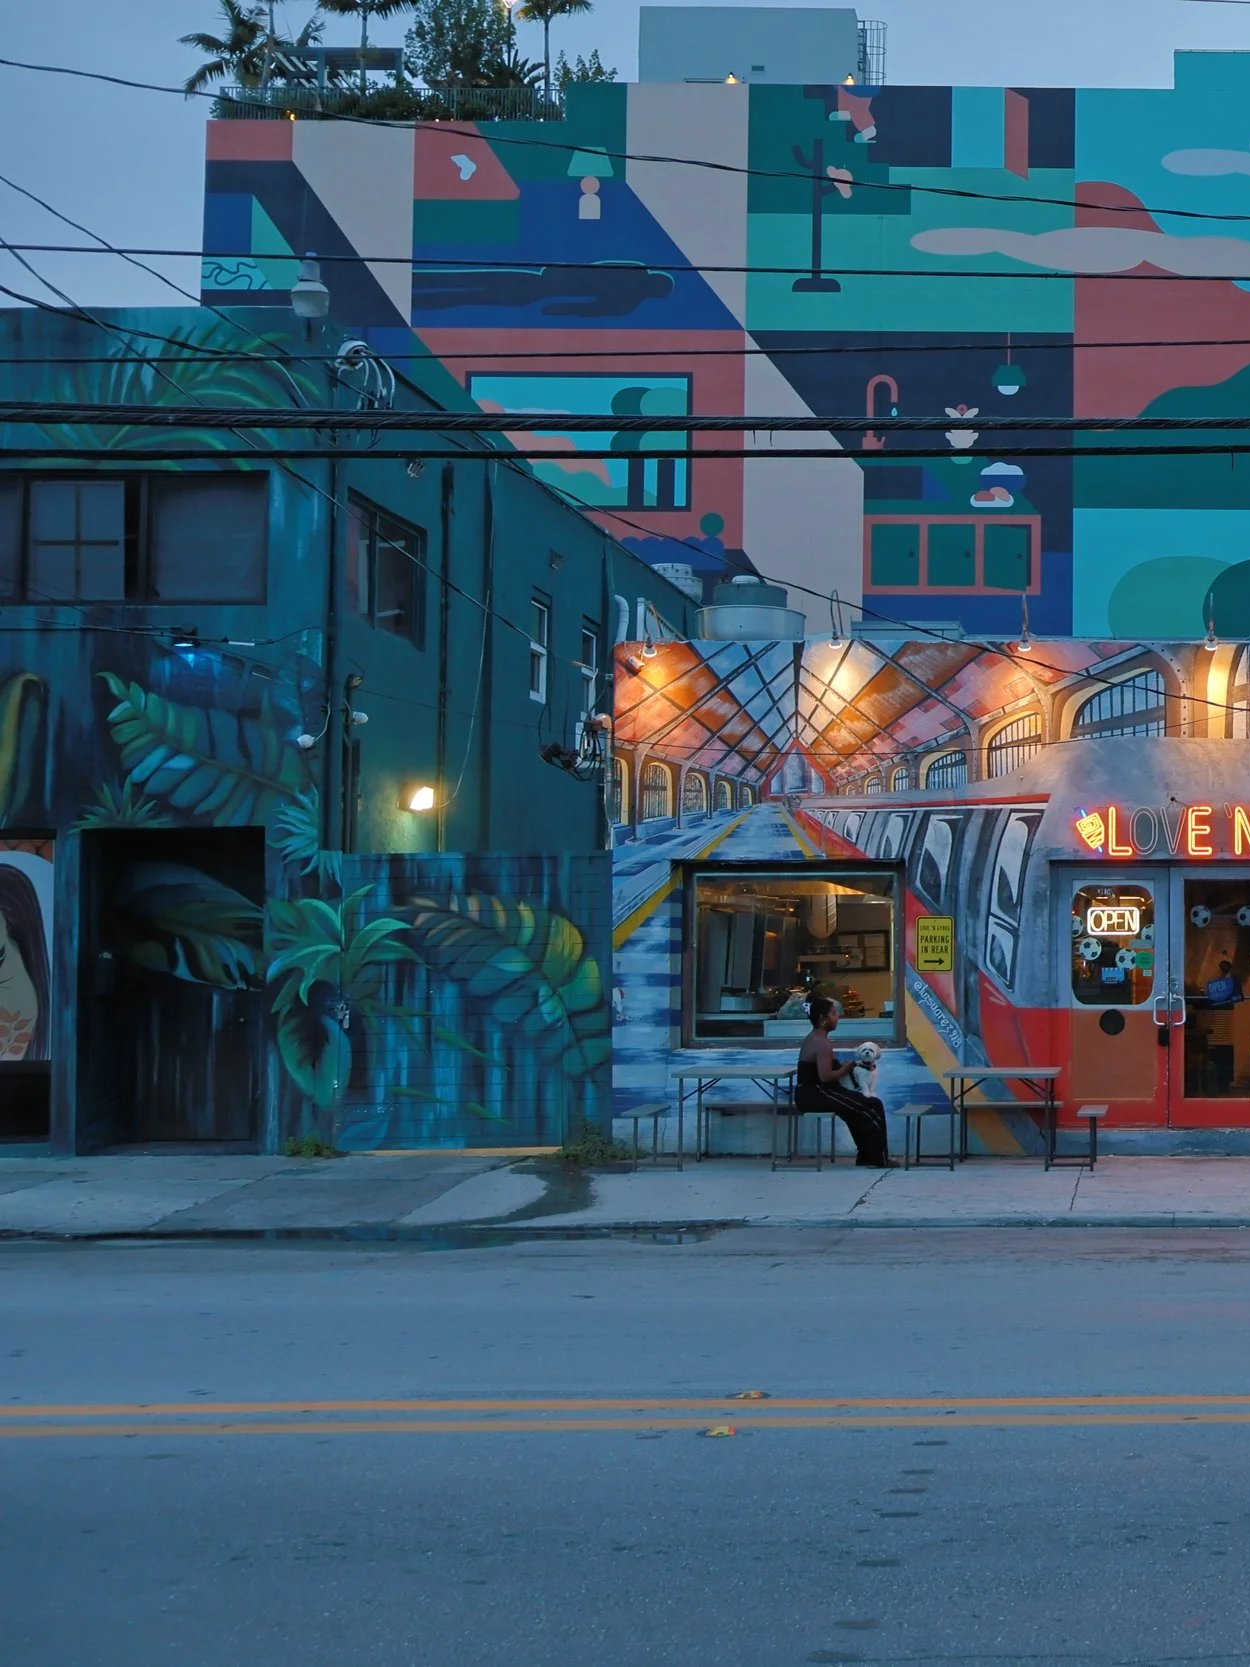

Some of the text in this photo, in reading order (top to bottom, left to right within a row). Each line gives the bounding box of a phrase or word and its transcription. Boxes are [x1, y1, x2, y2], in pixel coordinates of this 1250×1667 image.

[1108, 805, 1212, 857] LOVE
[1091, 910, 1137, 932] OPEN
[920, 935, 950, 944] PARKING
[921, 945, 949, 954] IN REAR
